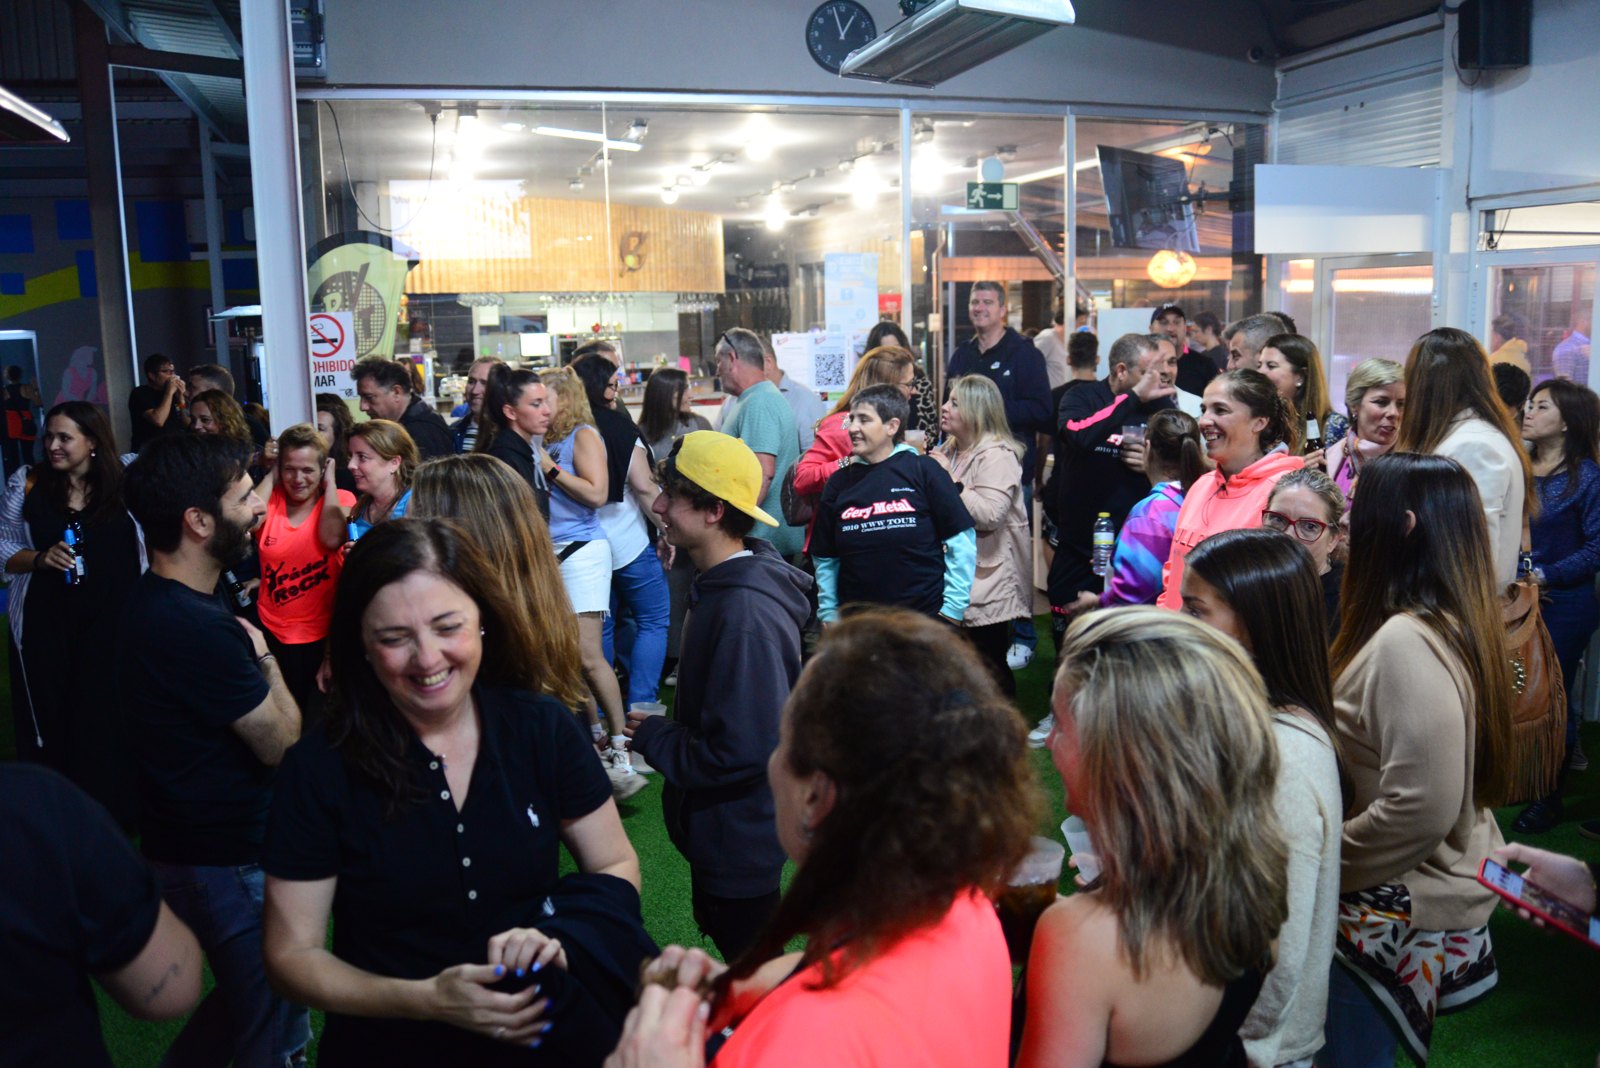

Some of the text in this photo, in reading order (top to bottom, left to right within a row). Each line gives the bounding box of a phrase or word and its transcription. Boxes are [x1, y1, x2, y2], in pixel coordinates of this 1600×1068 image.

[841, 498, 916, 520] Gery Metal
[842, 524, 860, 532] 2010
[887, 517, 916, 525] TOUR
